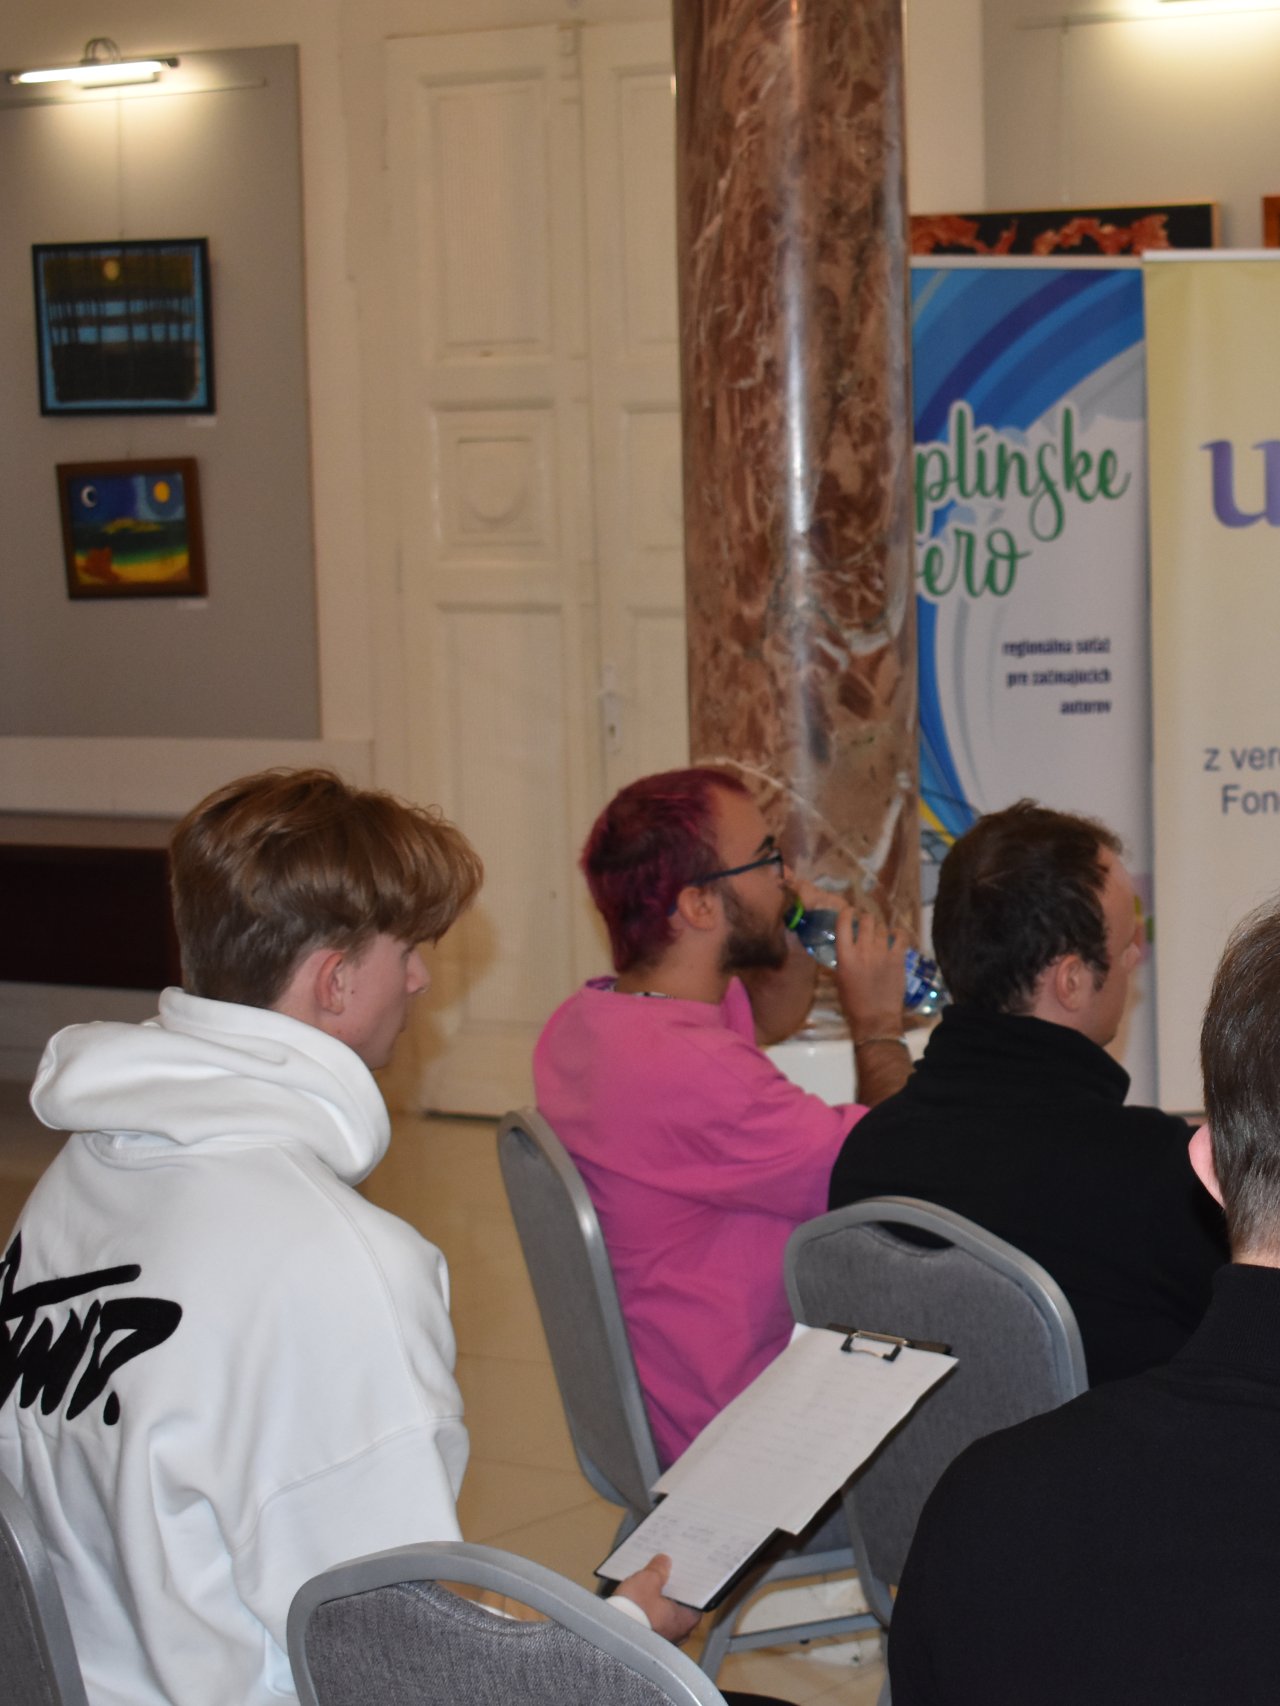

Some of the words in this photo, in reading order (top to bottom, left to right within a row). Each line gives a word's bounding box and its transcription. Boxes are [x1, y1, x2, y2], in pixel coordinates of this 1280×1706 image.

[914, 405, 1132, 542] plínske
[914, 526, 1033, 599] ero
[1006, 671, 1028, 689] pre
[1203, 748, 1221, 772] z
